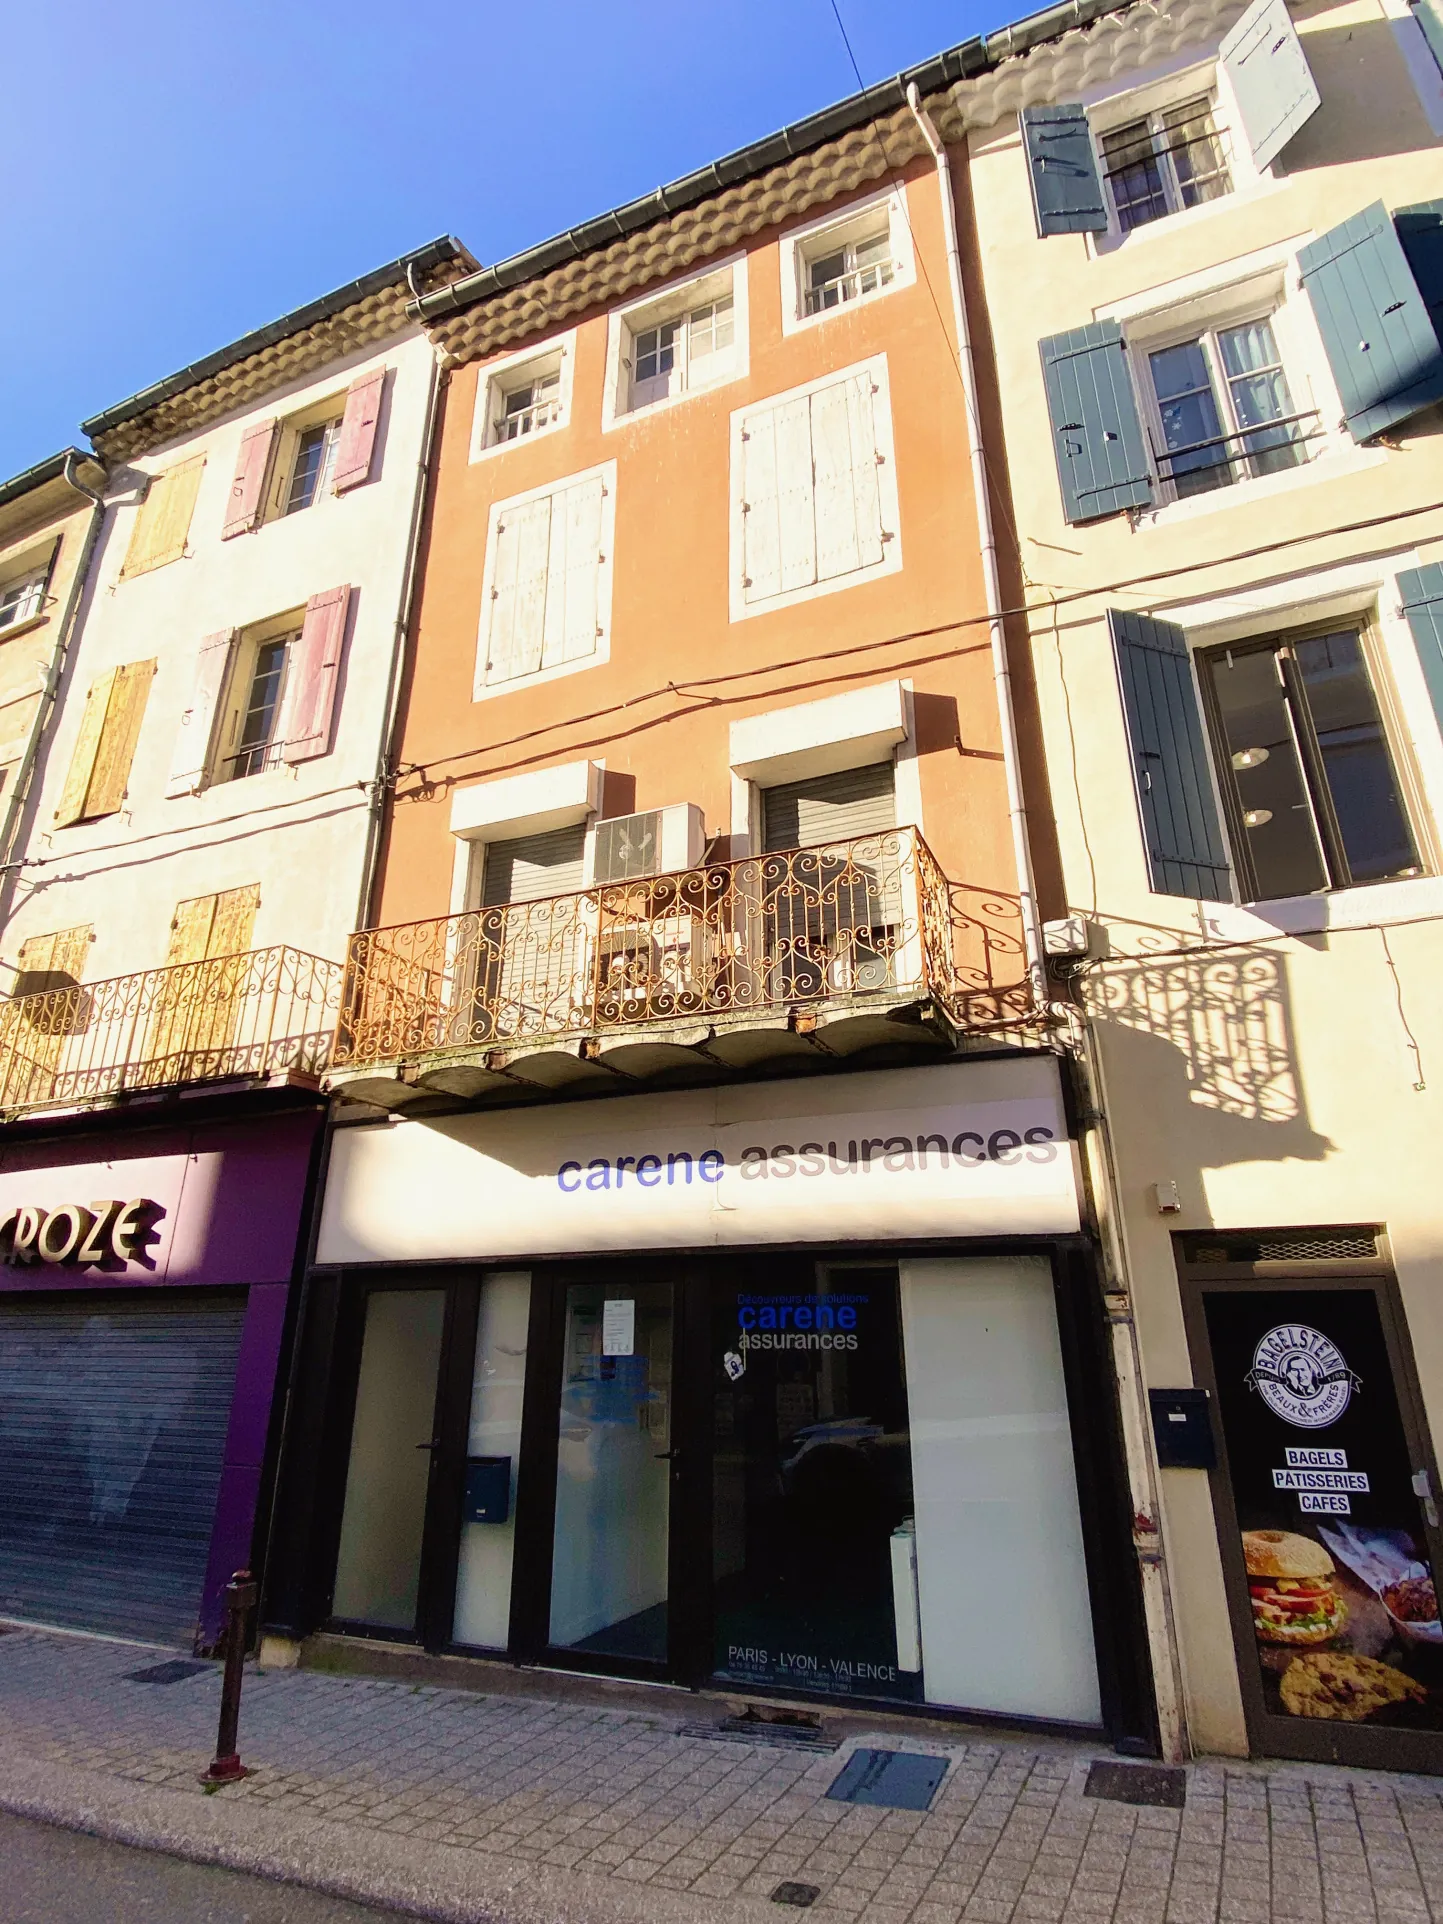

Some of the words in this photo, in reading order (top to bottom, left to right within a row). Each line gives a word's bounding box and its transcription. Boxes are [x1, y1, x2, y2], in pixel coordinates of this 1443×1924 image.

[557, 1149, 726, 1193] carene
[740, 1126, 1058, 1180] assurances
[738, 1305, 857, 1329] carene
[738, 1332, 858, 1350] assurances
[1257, 1328, 1342, 1371] BAGELSTEIN
[1268, 1383, 1298, 1414] BEAUX
[1297, 1402, 1313, 1418] &
[1288, 1450, 1345, 1466] BAGELS
[1301, 1495, 1348, 1511] CAFES
[727, 1645, 769, 1664] PARIS
[780, 1652, 818, 1671] LYON
[829, 1658, 897, 1682] VALENCE
